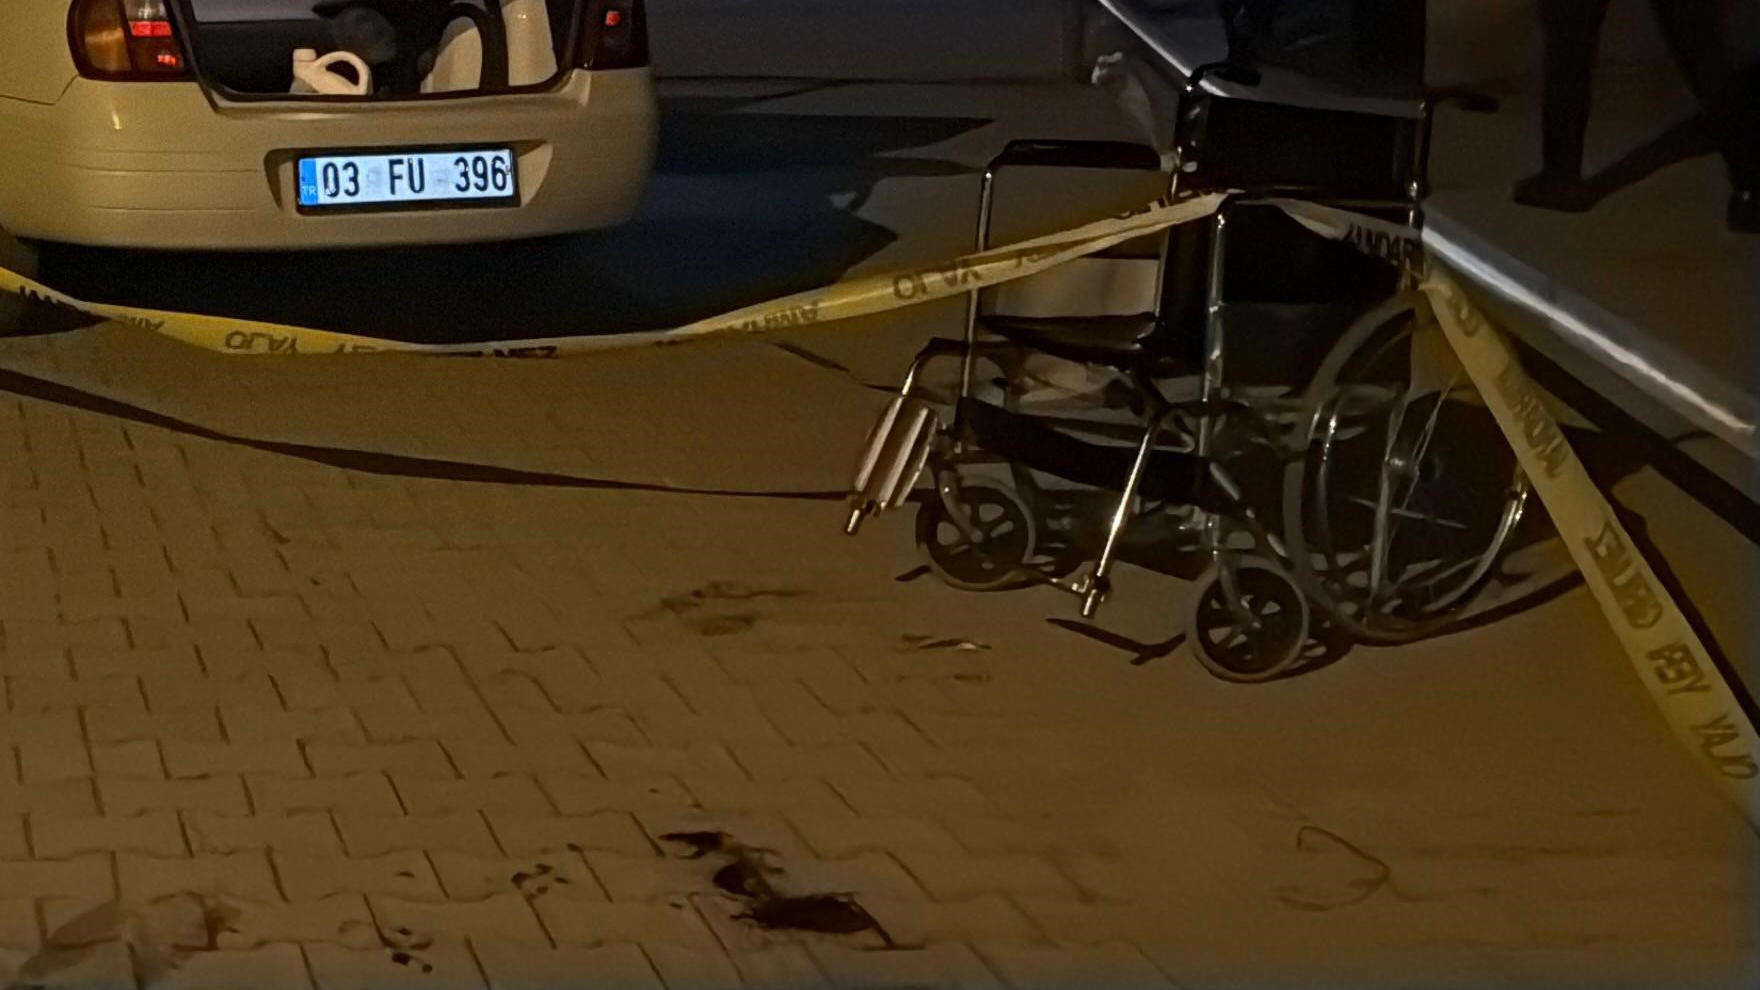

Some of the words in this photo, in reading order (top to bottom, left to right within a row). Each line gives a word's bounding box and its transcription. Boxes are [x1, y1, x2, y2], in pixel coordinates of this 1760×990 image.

[323, 162, 359, 197] 03
[388, 159, 426, 194] FU
[454, 156, 508, 192] 396
[301, 186, 318, 196] TR
